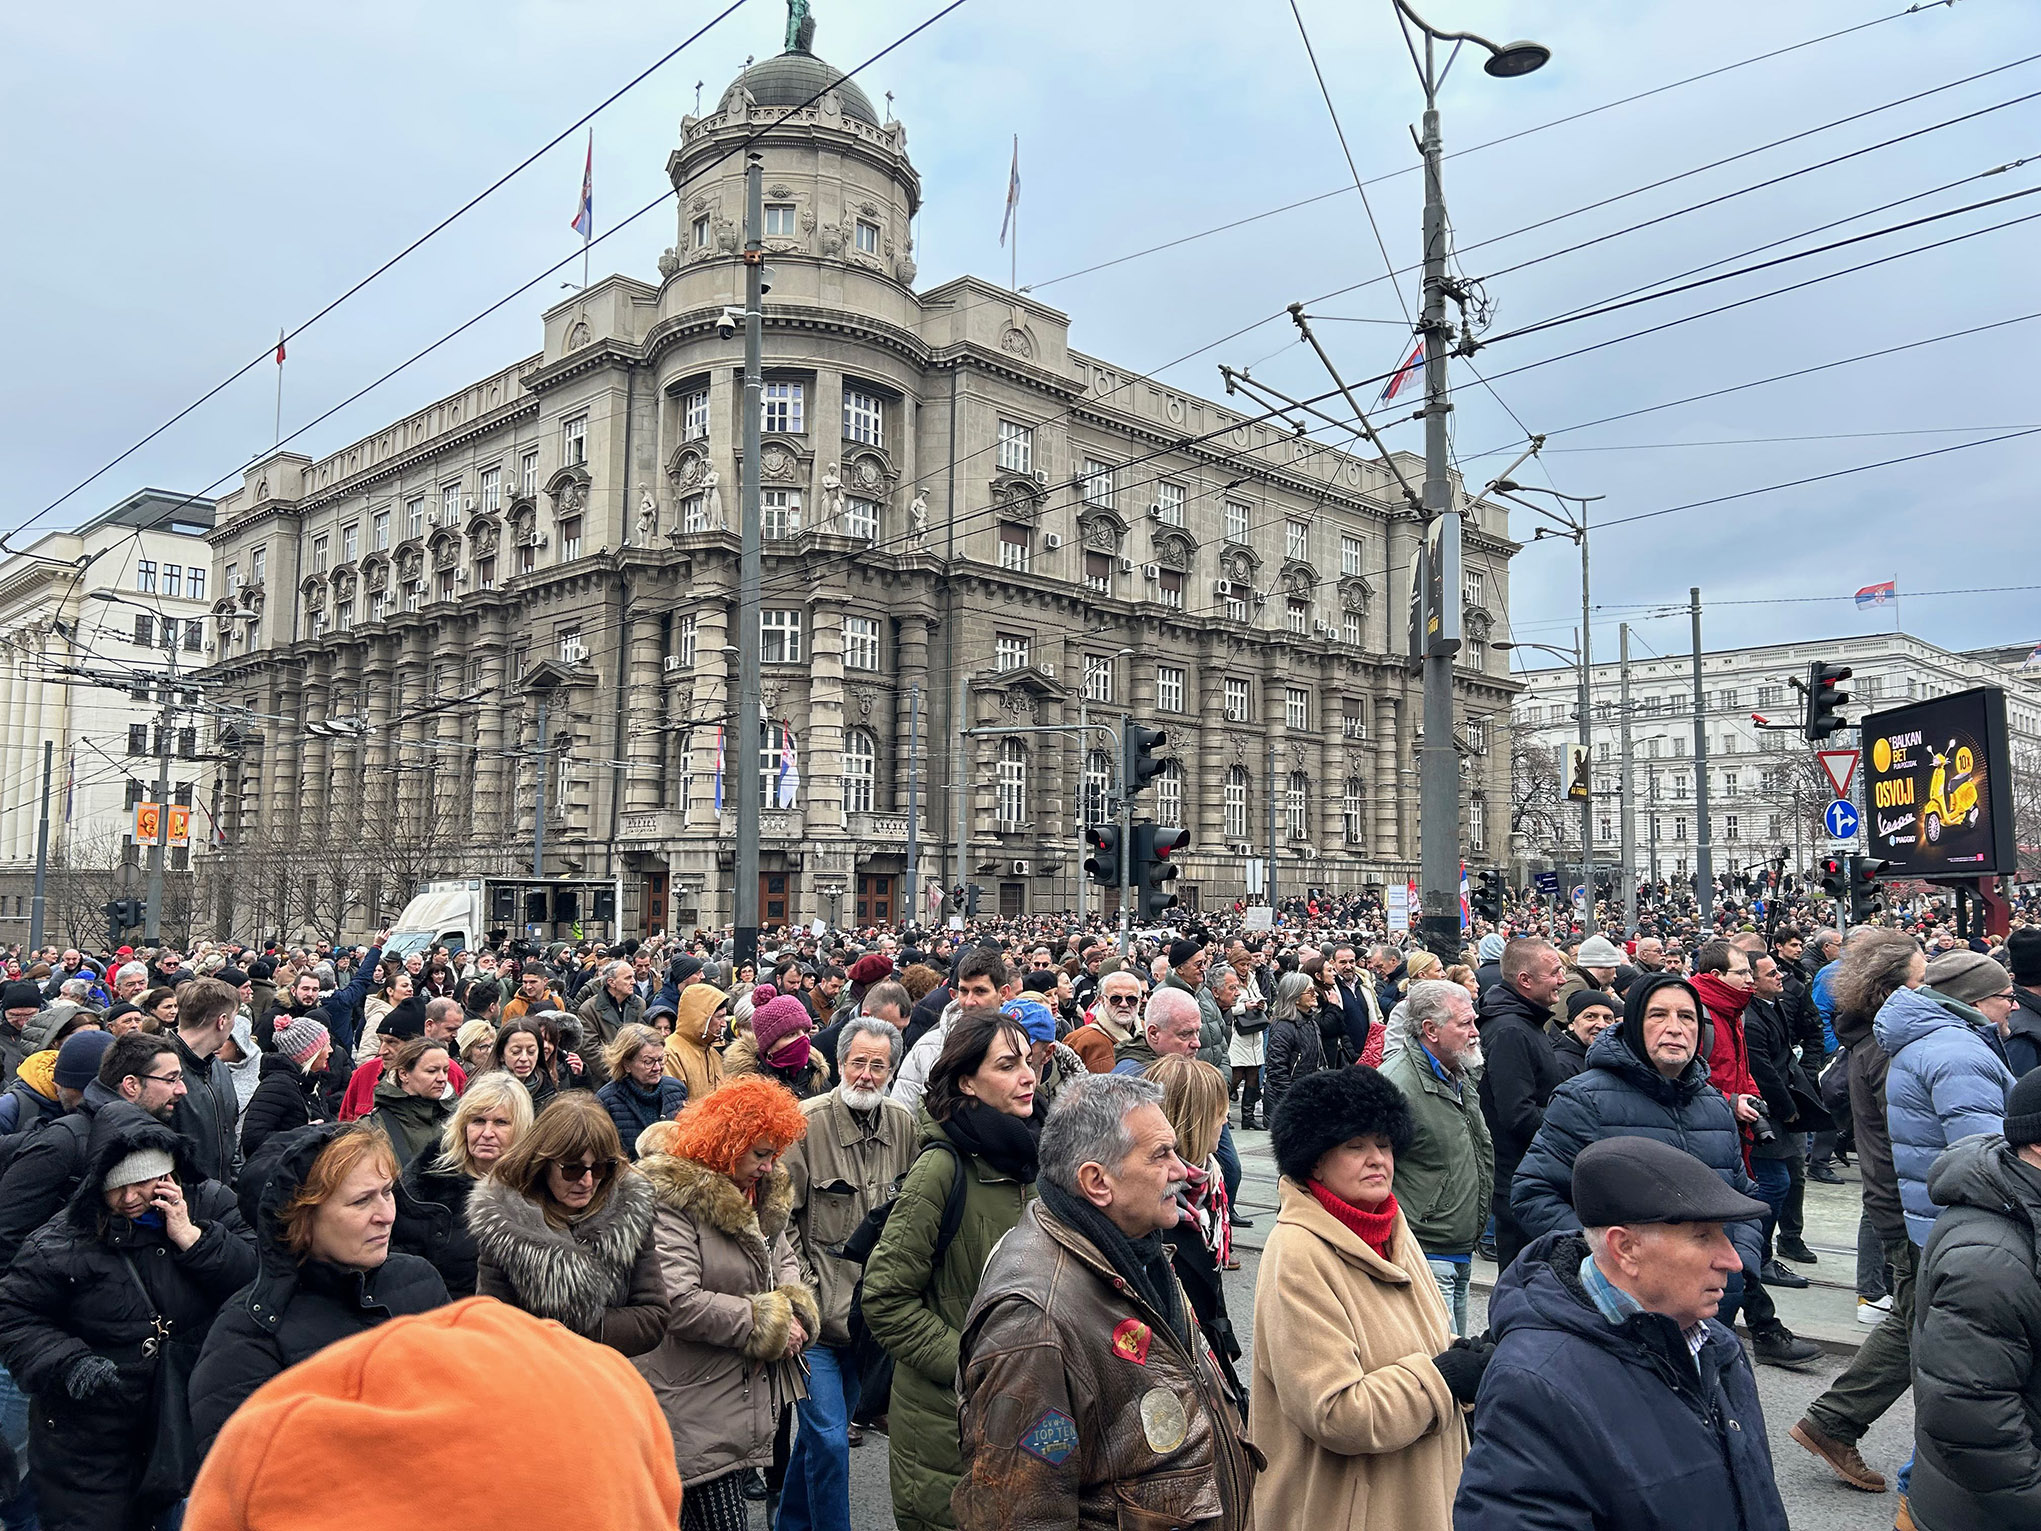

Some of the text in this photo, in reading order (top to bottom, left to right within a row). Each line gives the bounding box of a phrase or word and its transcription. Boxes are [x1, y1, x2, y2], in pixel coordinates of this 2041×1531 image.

[1892, 731, 1922, 749] BALKAN
[1893, 748, 1907, 762] BET
[1875, 777, 1914, 809] OSVOJI
[1878, 811, 1916, 837] Vespa
[1034, 1425, 1076, 1441] TOP TEN
